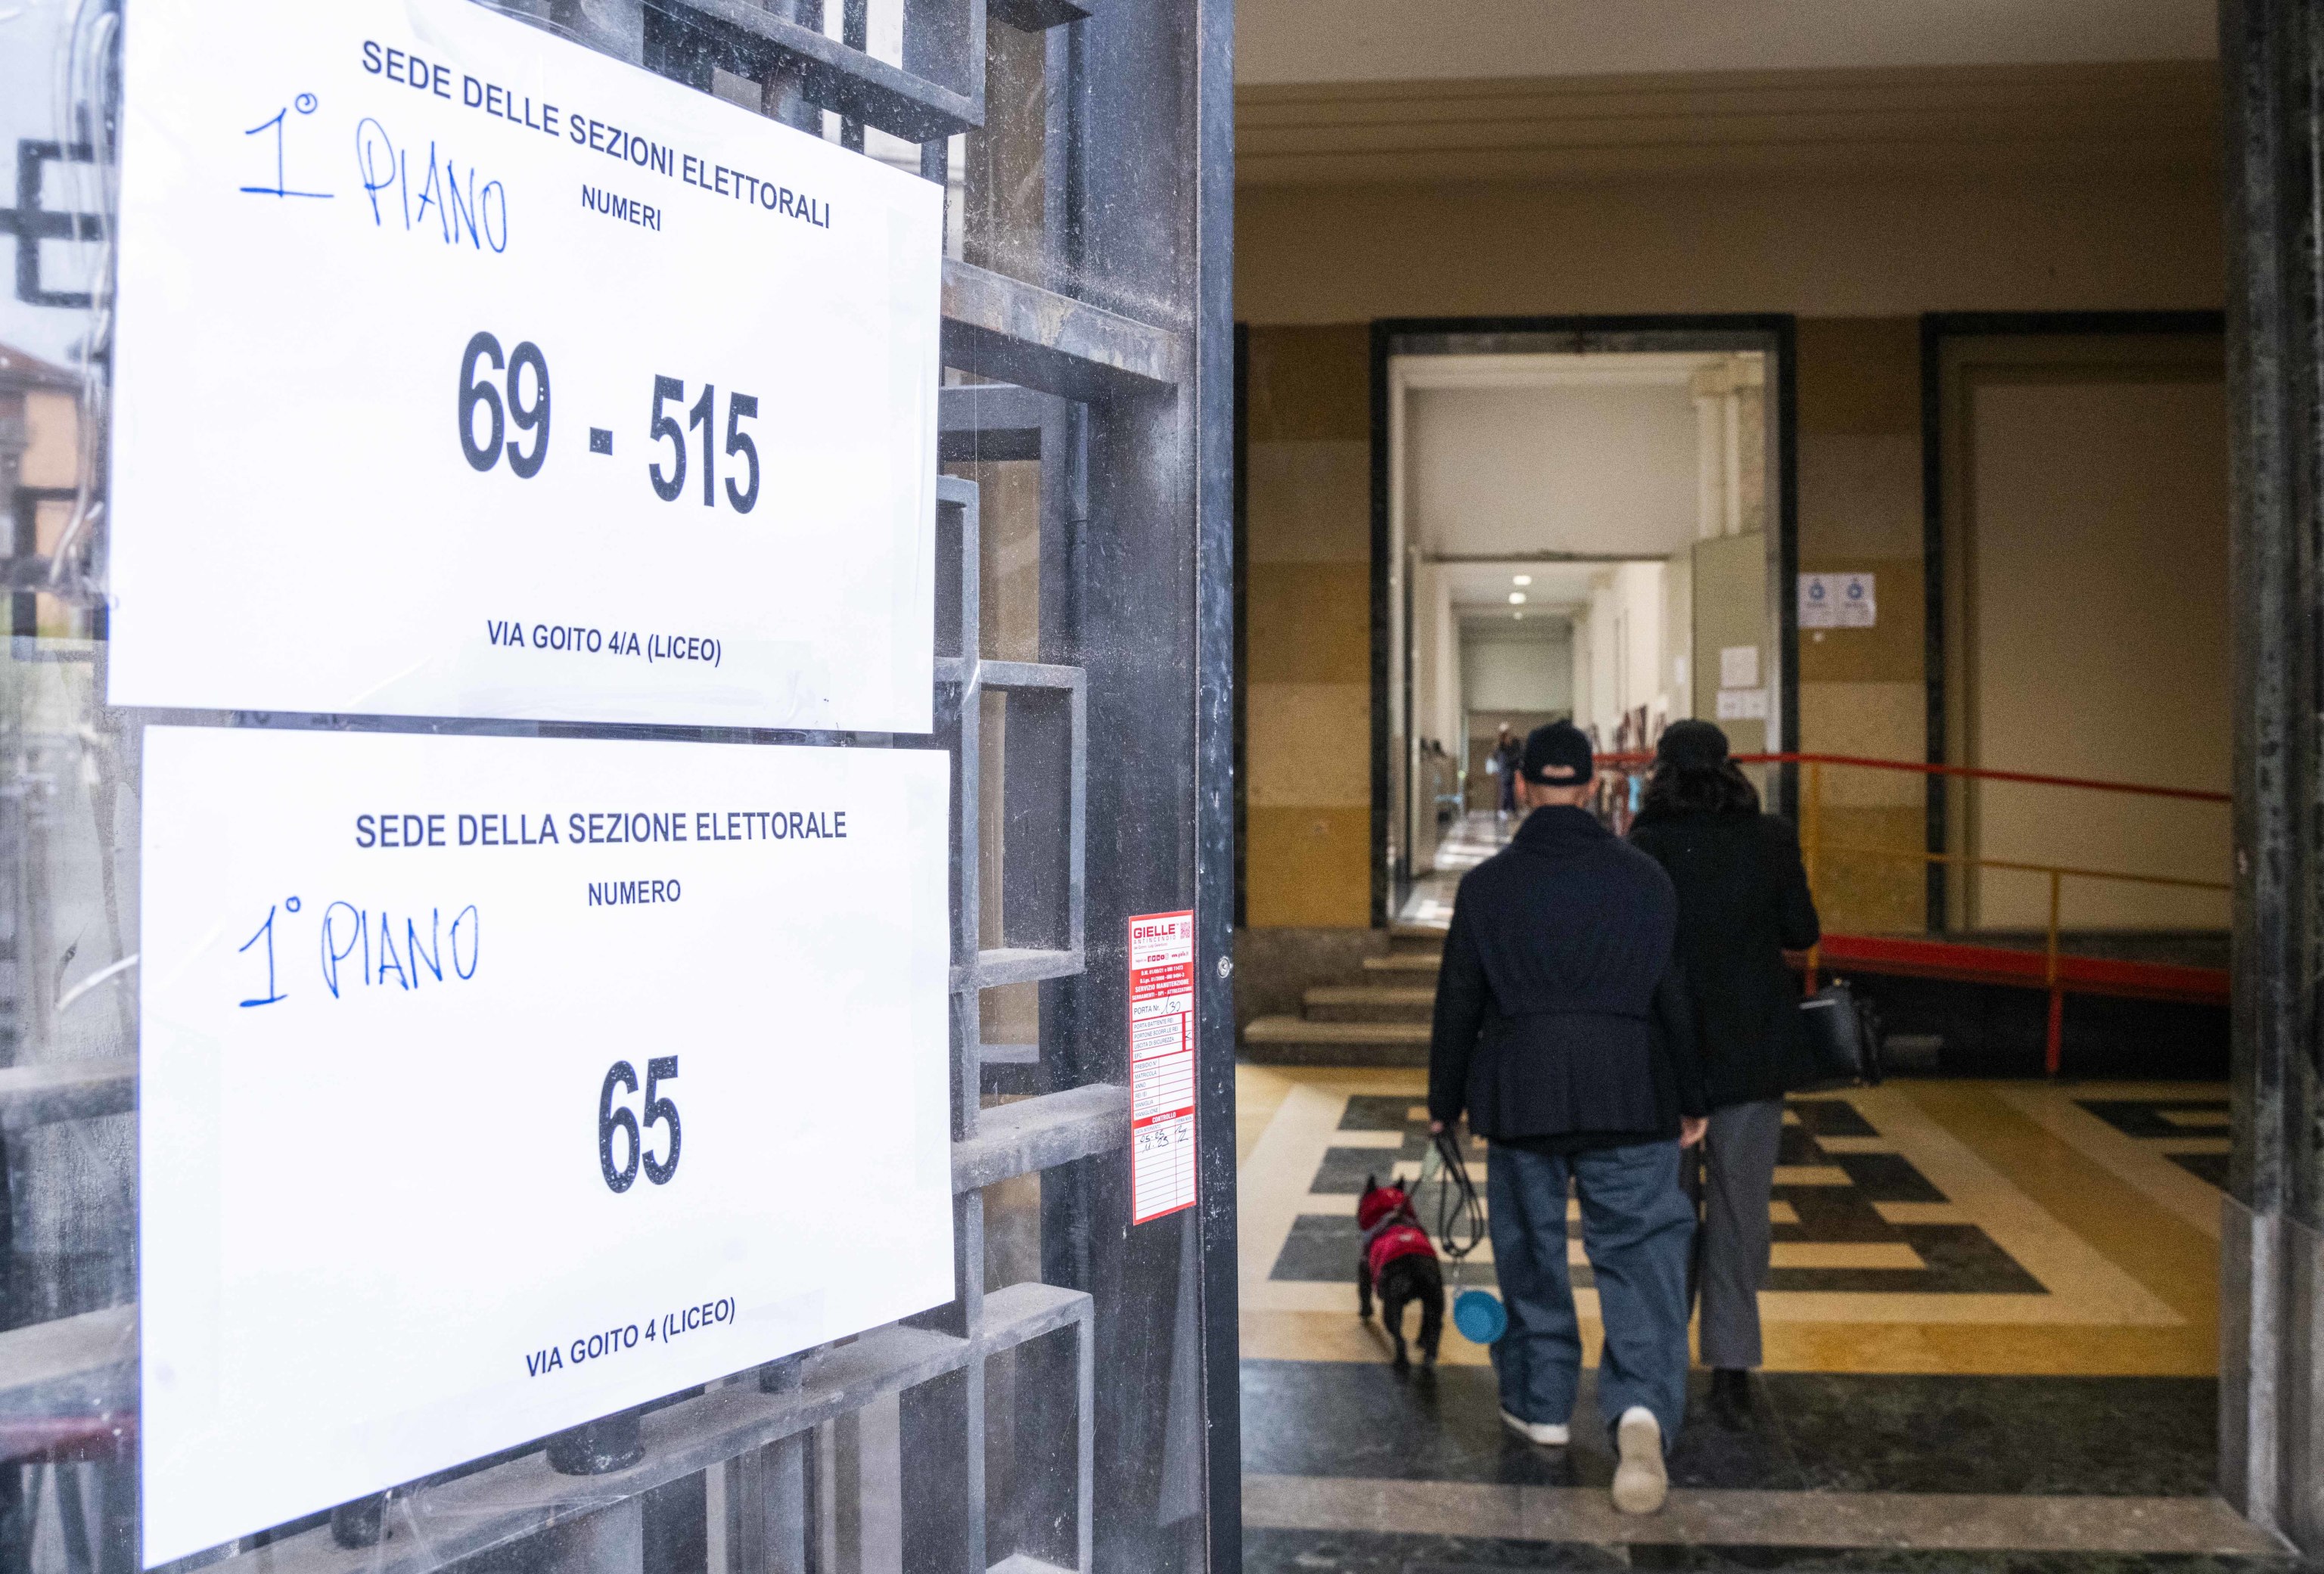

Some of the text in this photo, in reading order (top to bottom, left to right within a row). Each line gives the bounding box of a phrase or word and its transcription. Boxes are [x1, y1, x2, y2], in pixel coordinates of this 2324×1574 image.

[362, 40, 829, 229] SEDE DELLE SEZIONI ELETTORALI
[240, 92, 507, 253] 1° PIANO
[582, 184, 662, 231] NUMERI
[458, 331, 760, 514] 69 - 515
[487, 619, 721, 668] VIA GOITO 4/A (LICEO)
[356, 811, 847, 849] SEDE DELLA SEZIONE ELETTORALE
[589, 879, 681, 907] NUMERO
[1134, 924, 1176, 939] GIELLE
[1134, 935, 1176, 944] ANTINCENDIO
[238, 896, 478, 1008] 1° PIANO
[1135, 979, 1189, 992] SERVIZIO MANUTENZIONE
[1134, 1006, 1152, 1015] PORTA
[1148, 1019, 1167, 1027] BATTENTE
[1134, 1031, 1152, 1039] PORTONE
[1154, 1036, 1174, 1045] SICUREZZA
[1134, 1070, 1157, 1079] MATRICOLA
[1135, 1099, 1154, 1108] MANIGLIA
[1135, 1107, 1158, 1117] MANIGLIONE
[1152, 1112, 1176, 1123] CONTROLLO
[598, 1054, 682, 1194] 65
[1144, 1124, 1161, 1132] INTERVENTO
[526, 1296, 735, 1377] VIA GOITO 4 (LICEO)
